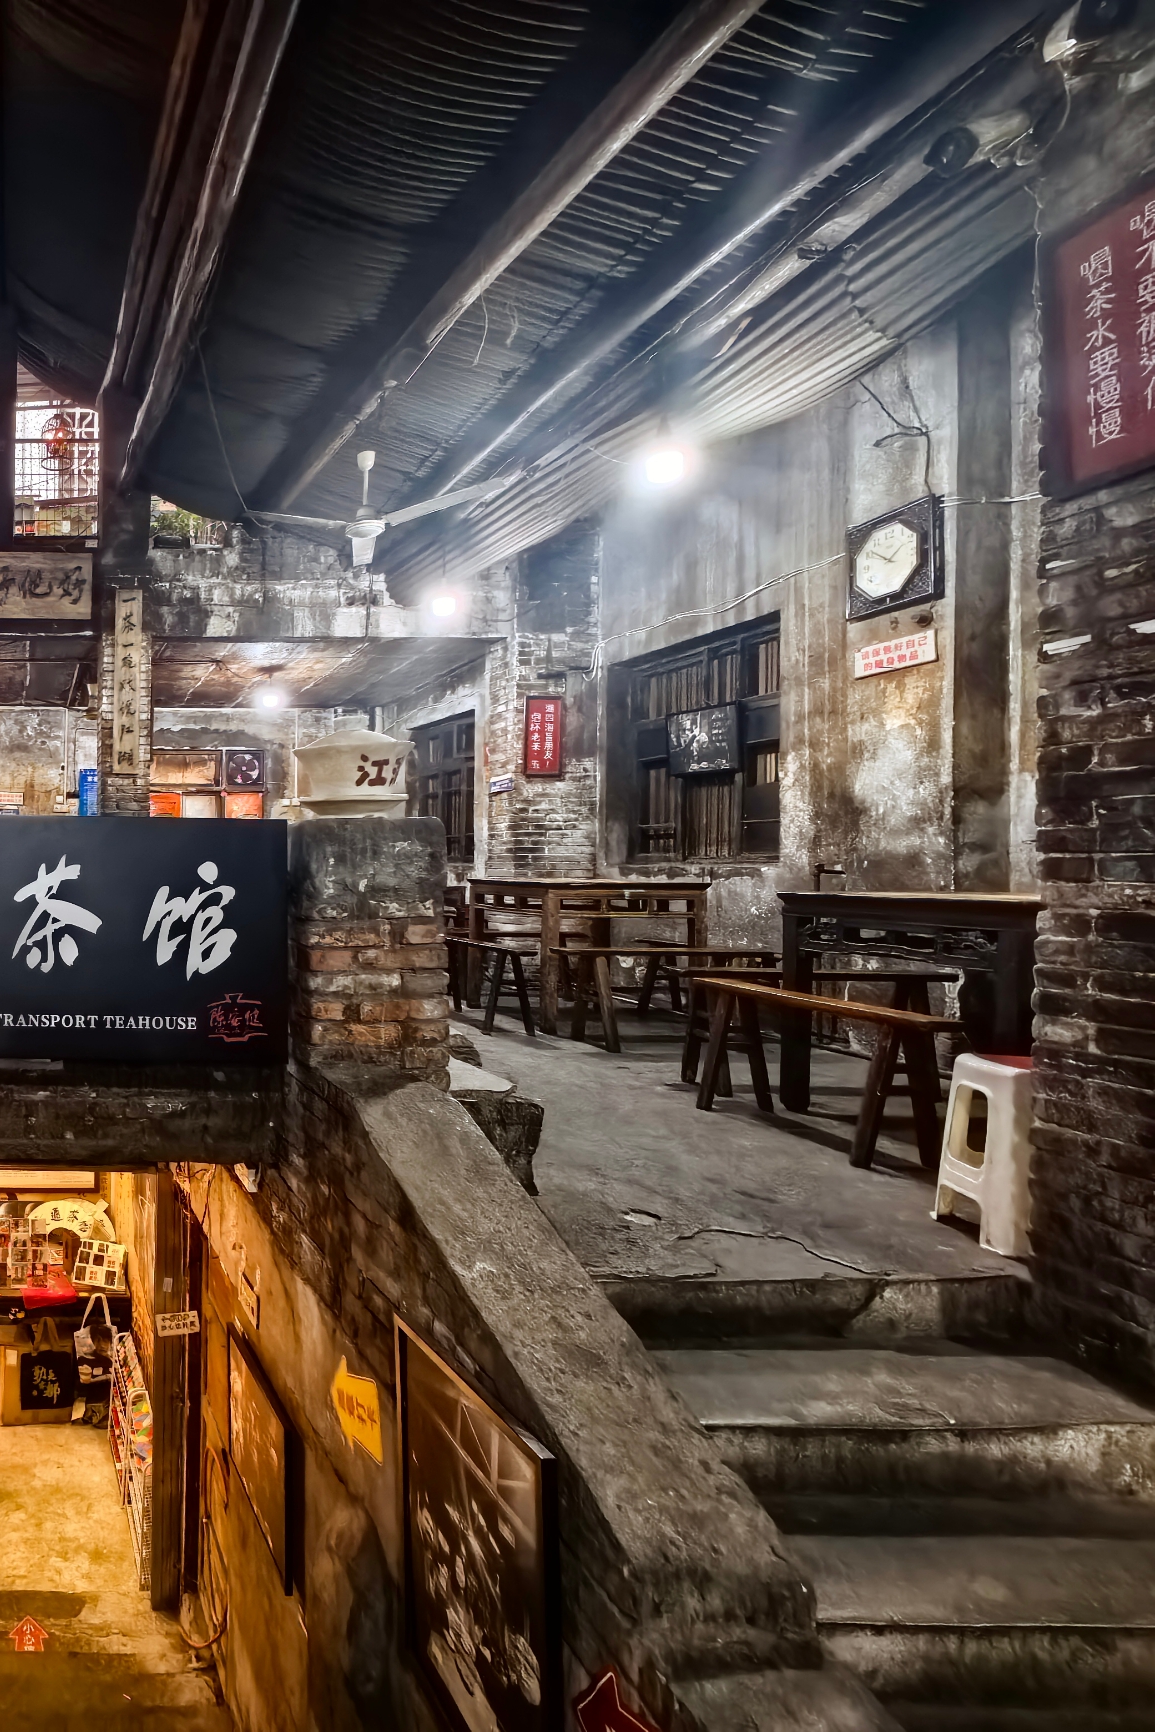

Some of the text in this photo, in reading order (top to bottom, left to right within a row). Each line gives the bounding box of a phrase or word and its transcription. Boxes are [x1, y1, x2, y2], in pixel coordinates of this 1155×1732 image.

[1079, 245, 1127, 448] 喝茶水要慢慢
[860, 635, 928, 661] 请保管好自己
[863, 650, 919, 672] 的随身物品
[102, 1015, 197, 1030] TEAHOUSE
